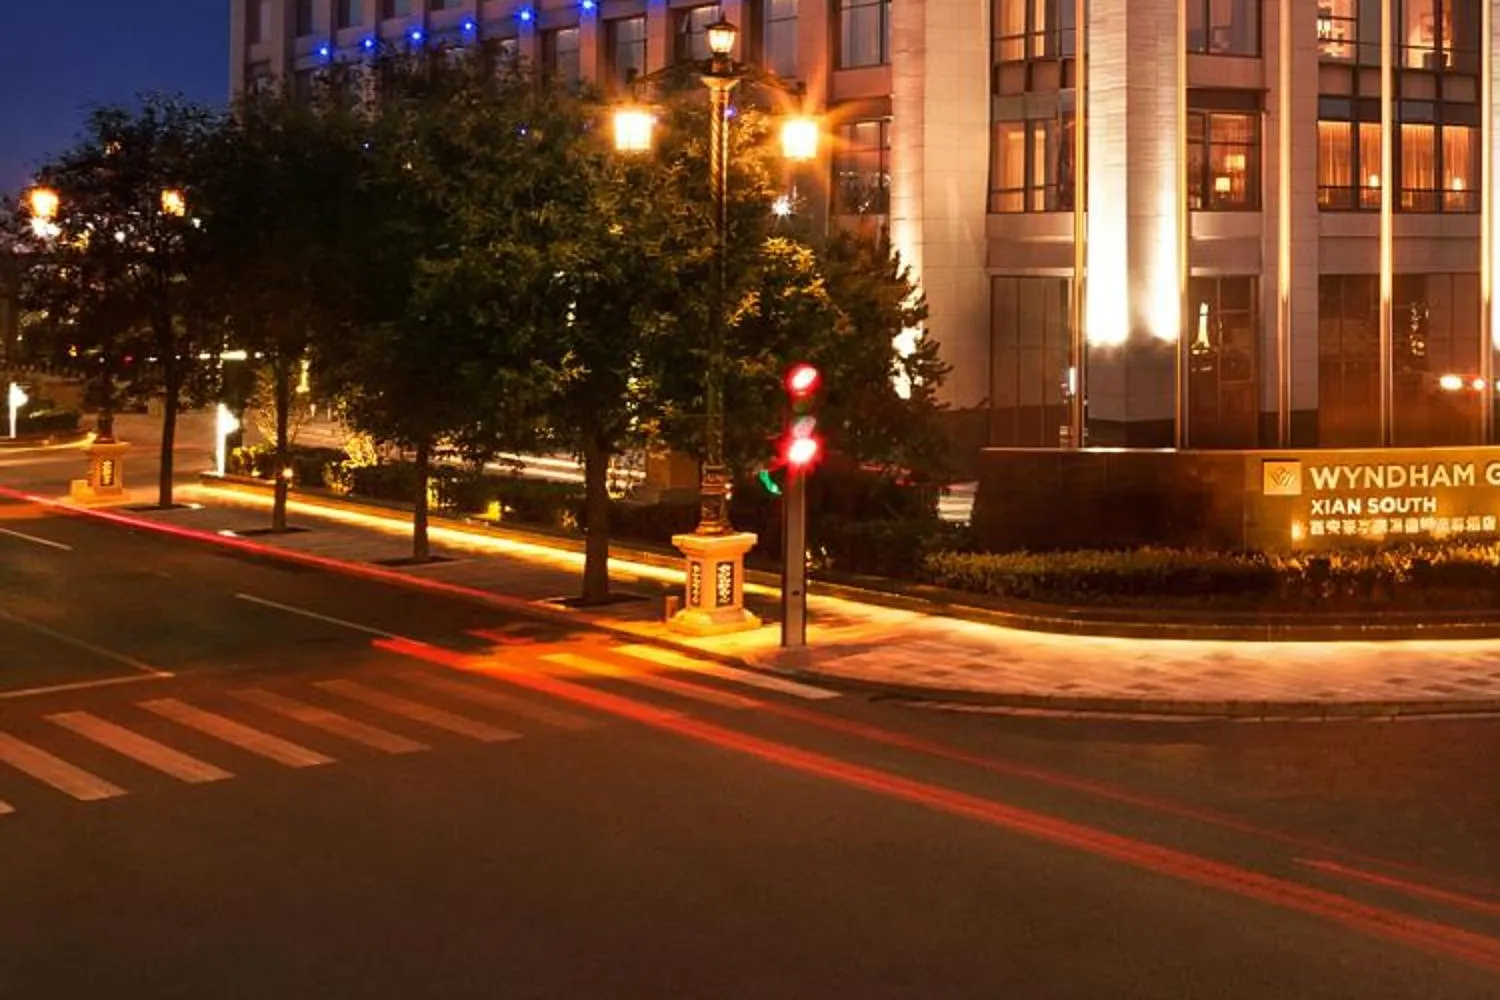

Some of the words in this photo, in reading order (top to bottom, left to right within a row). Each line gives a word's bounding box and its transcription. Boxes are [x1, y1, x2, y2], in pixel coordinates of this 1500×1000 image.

[1310, 463, 1475, 490] WYNDHAM
[1311, 498, 1361, 515] XIAN
[1367, 496, 1437, 514] SOUTH
